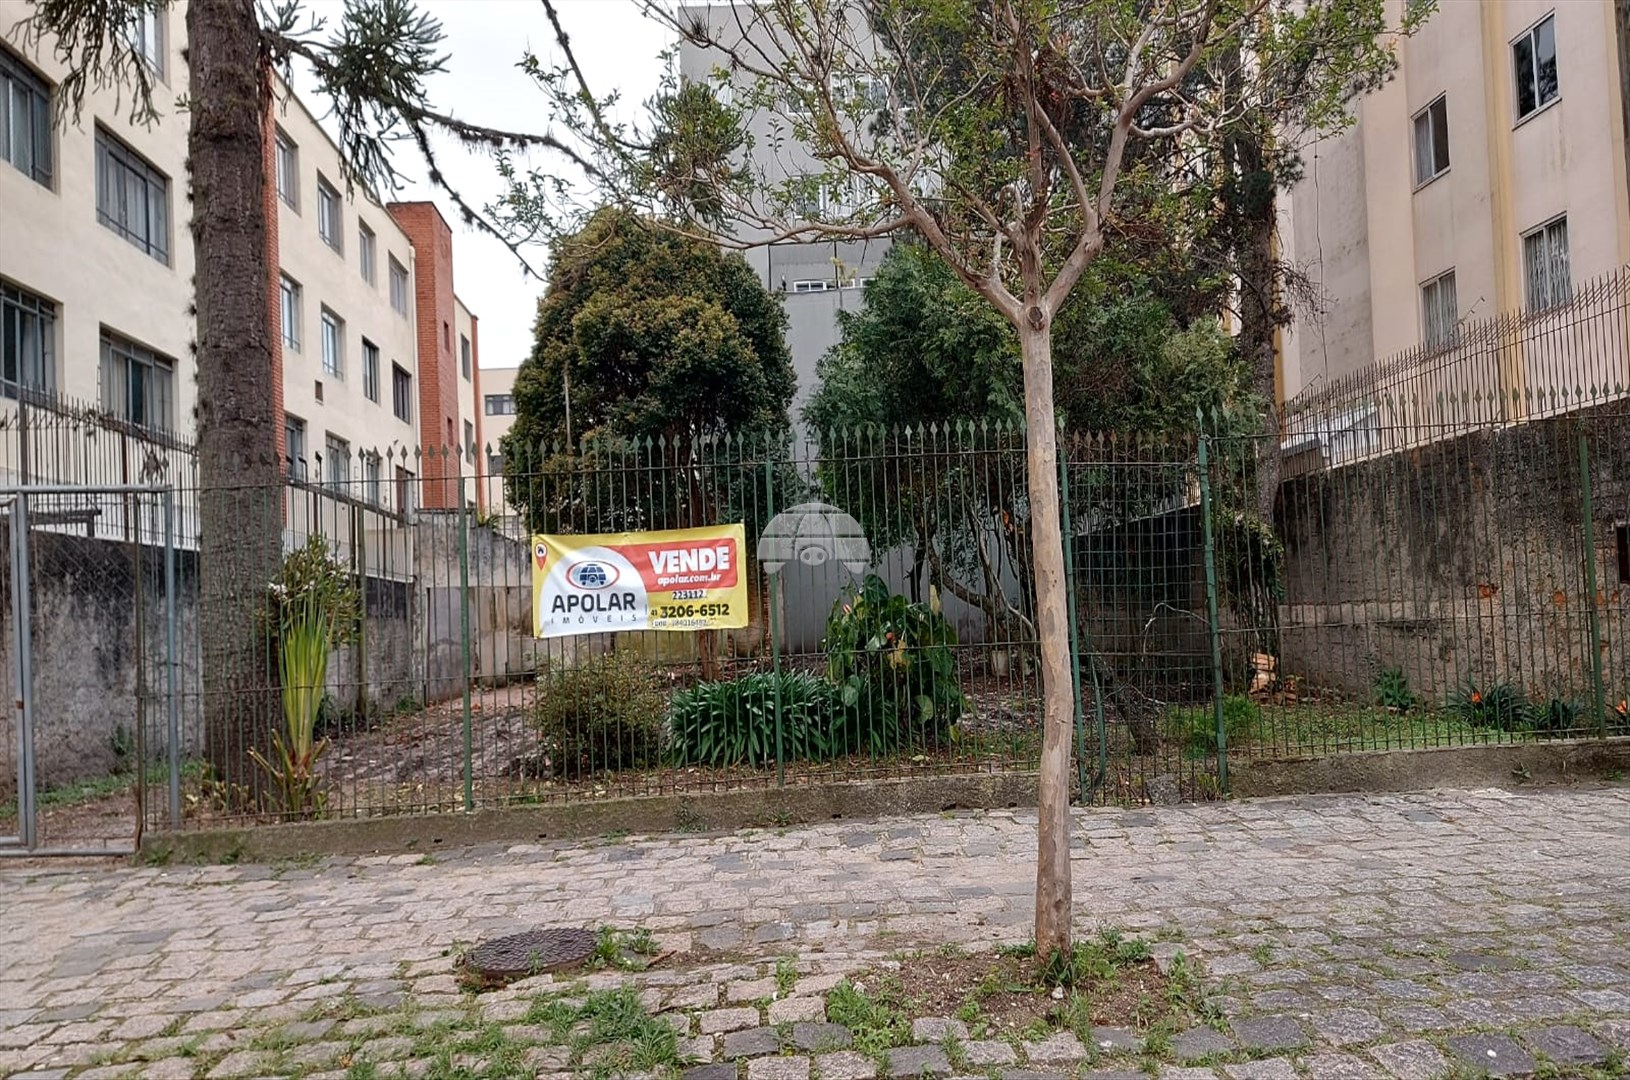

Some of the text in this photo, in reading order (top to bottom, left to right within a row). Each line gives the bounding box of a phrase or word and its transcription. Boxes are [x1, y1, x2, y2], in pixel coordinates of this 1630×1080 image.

[648, 546, 730, 575] VENDE
[657, 572, 722, 586] apolar.com.br
[551, 592, 636, 613] APOLAR
[660, 603, 730, 618] 3206-6512
